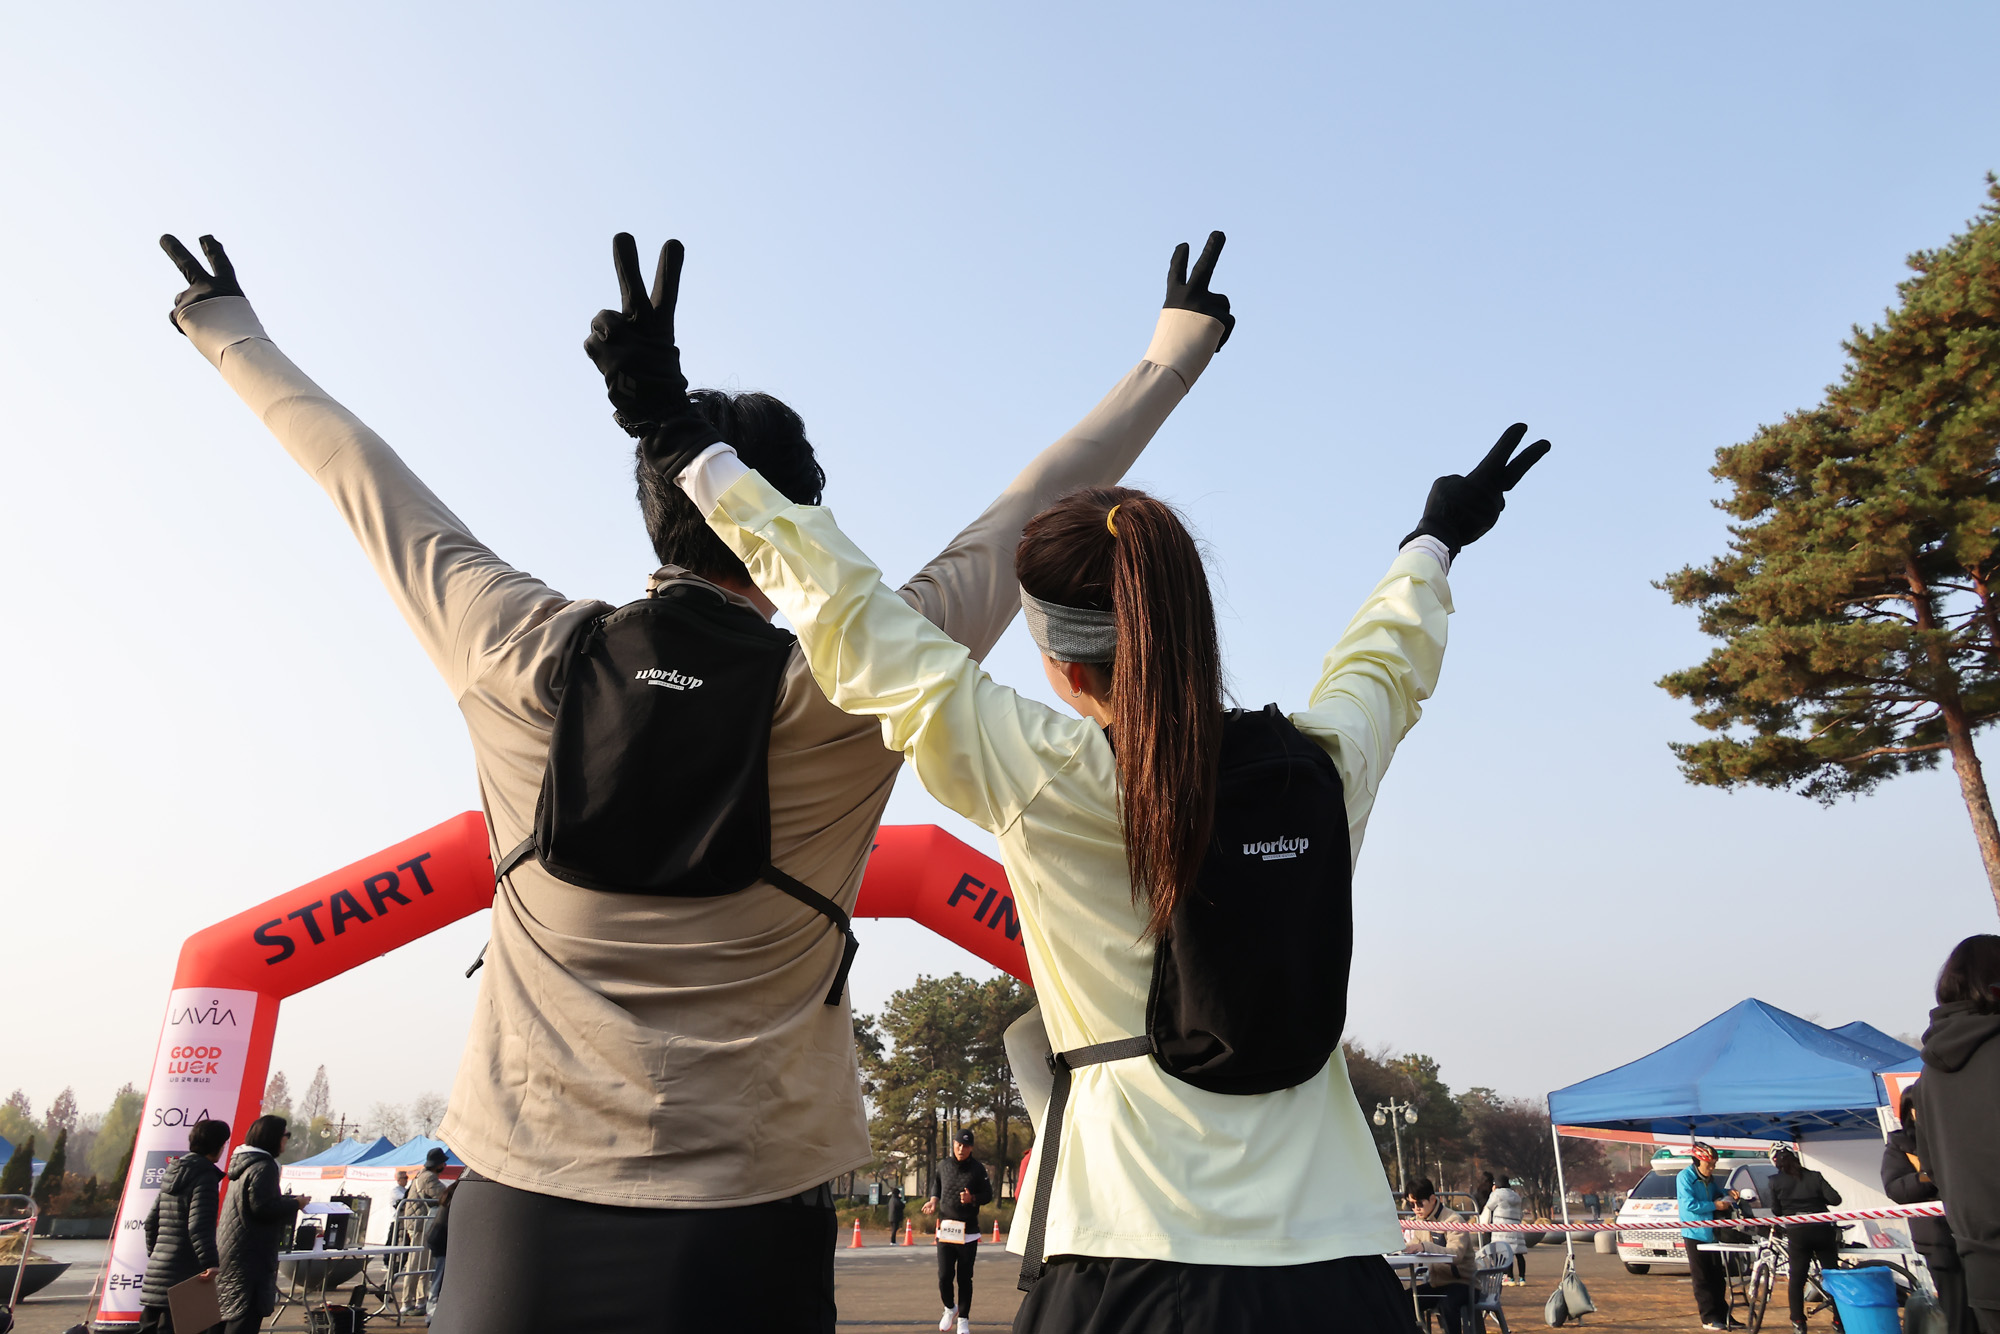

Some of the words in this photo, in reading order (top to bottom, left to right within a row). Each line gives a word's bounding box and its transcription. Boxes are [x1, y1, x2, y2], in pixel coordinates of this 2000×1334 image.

[634, 667, 703, 689] workup
[1242, 835, 1309, 855] workup
[253, 851, 434, 966] START
[946, 872, 1025, 947] FIN
[170, 1046, 222, 1060] GOOD
